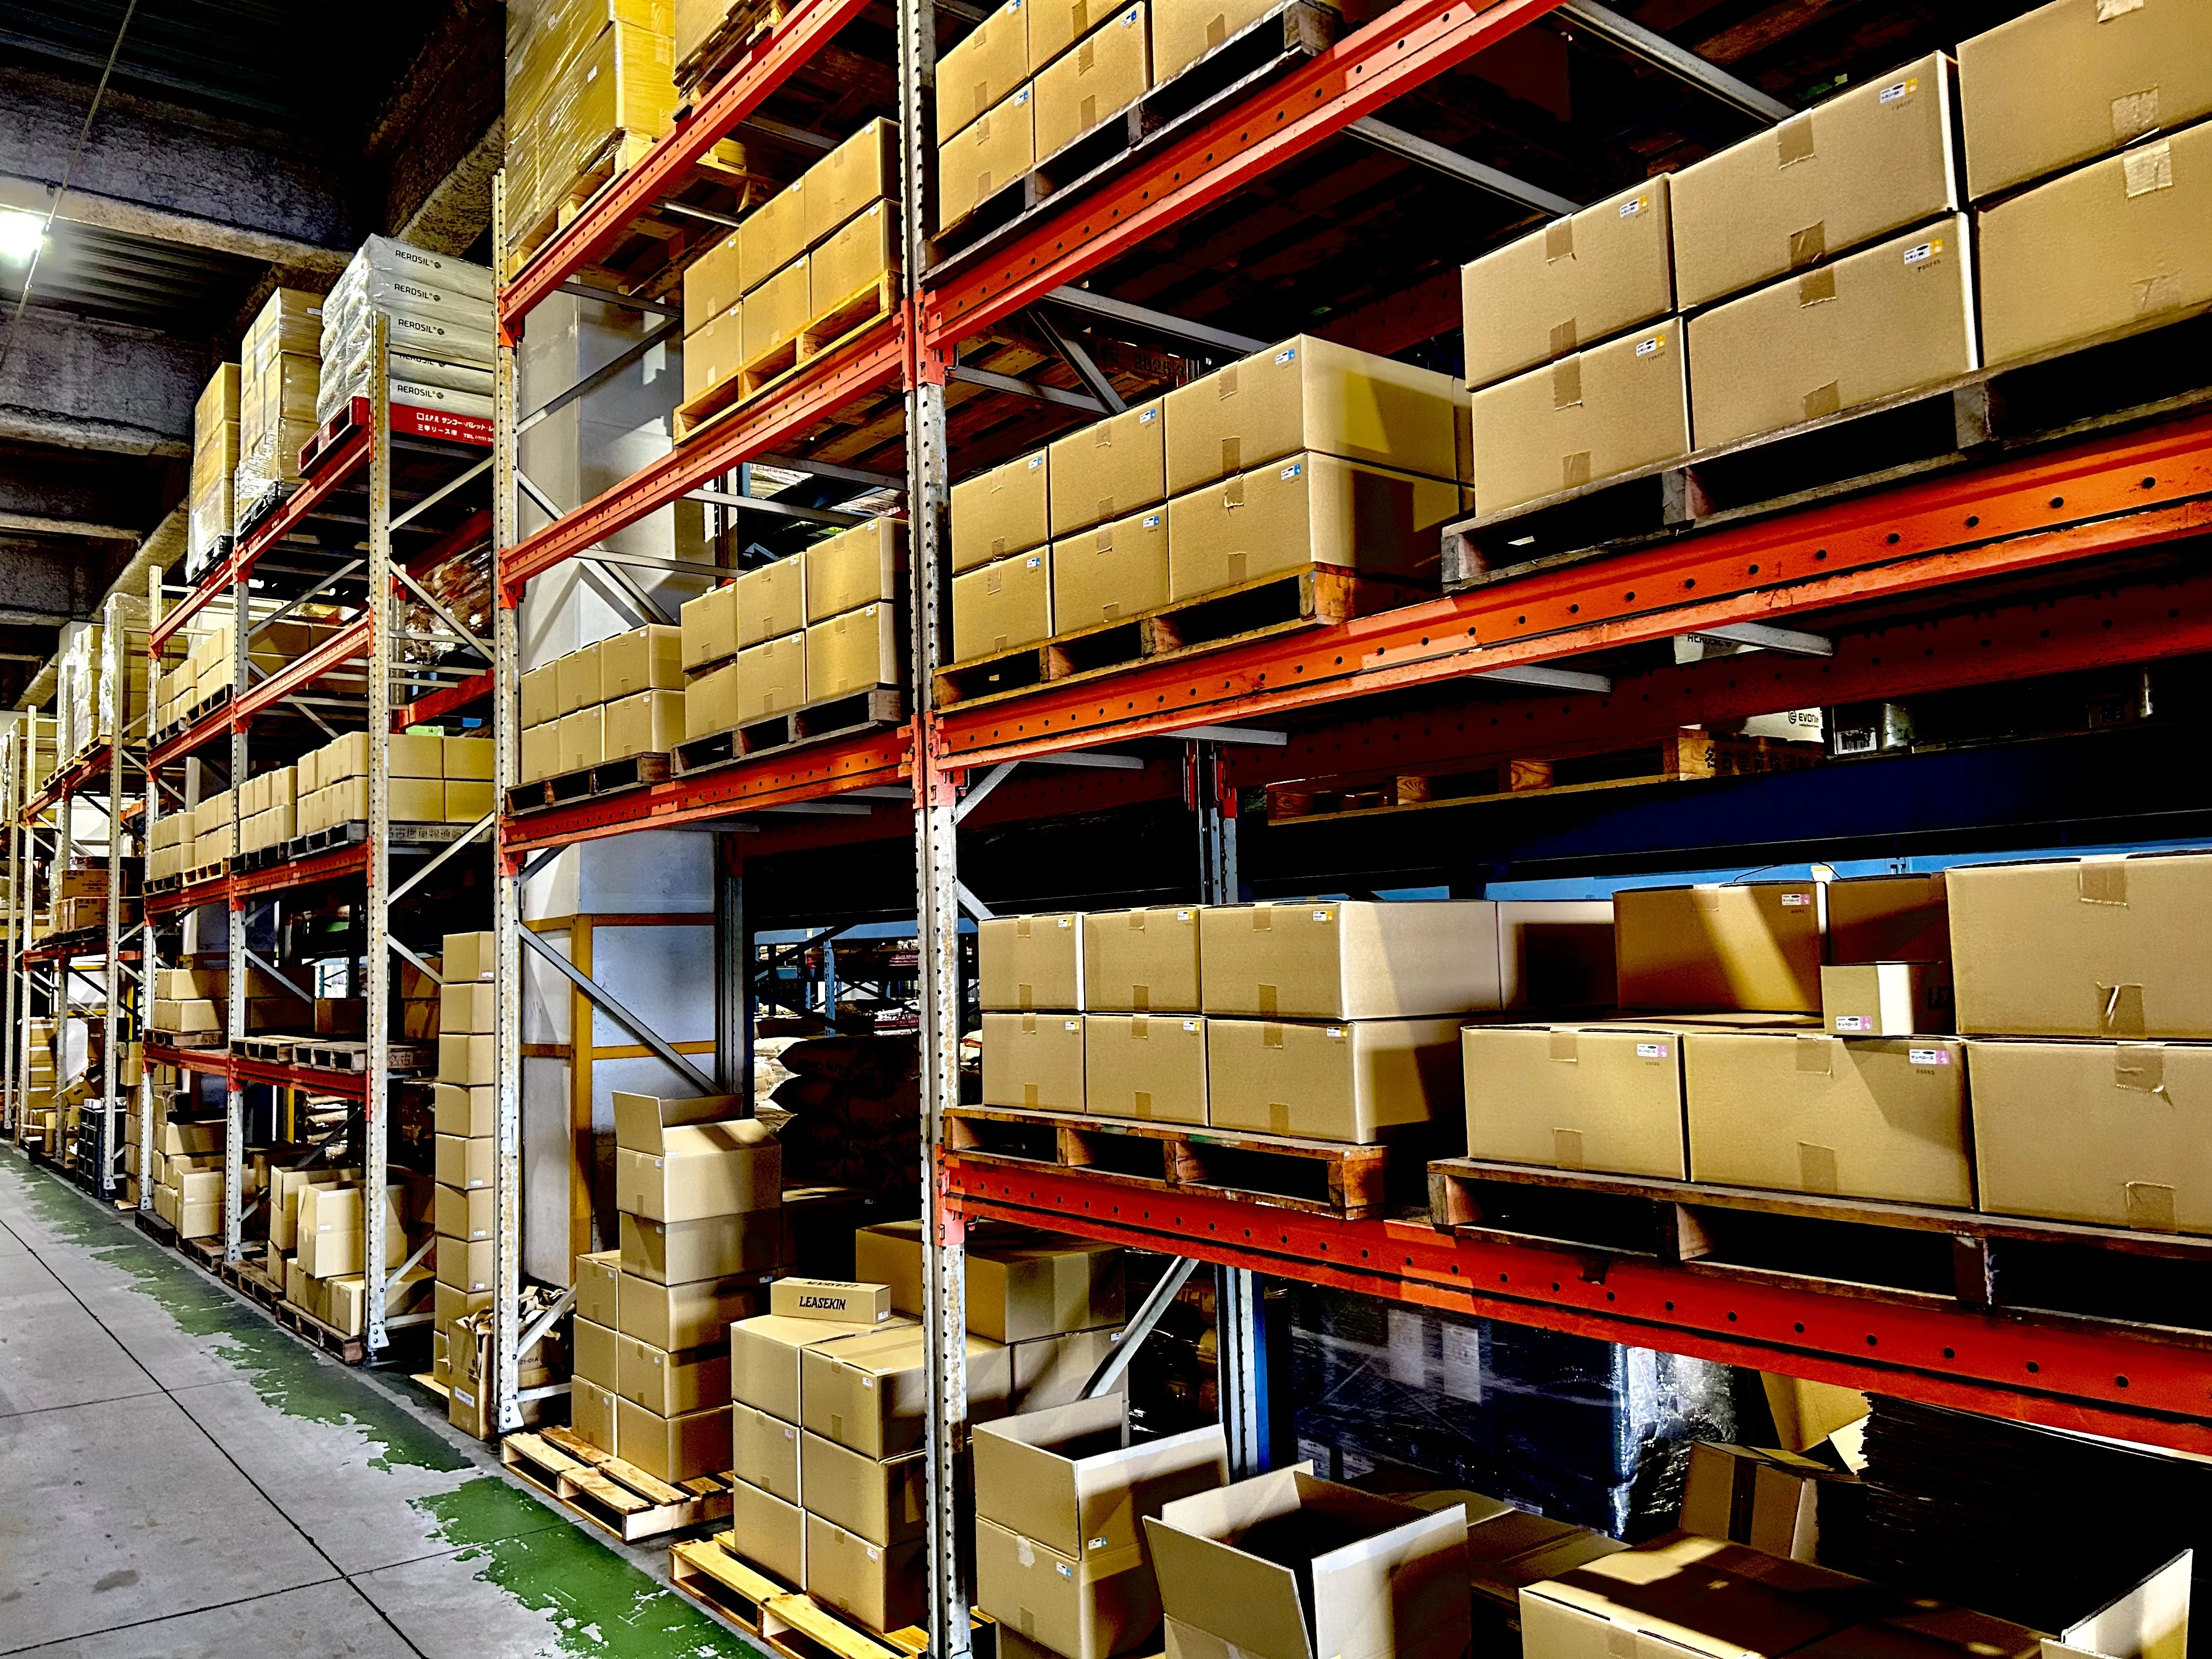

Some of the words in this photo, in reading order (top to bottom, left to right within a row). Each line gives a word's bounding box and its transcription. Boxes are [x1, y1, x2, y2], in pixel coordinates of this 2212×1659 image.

[395, 250, 430, 267] AEROSIL
[394, 283, 429, 300] AEROSIL
[398, 318, 433, 334] AEROSIL
[397, 385, 433, 398] AEROSIL
[799, 1296, 846, 1310] LEASEKIN
